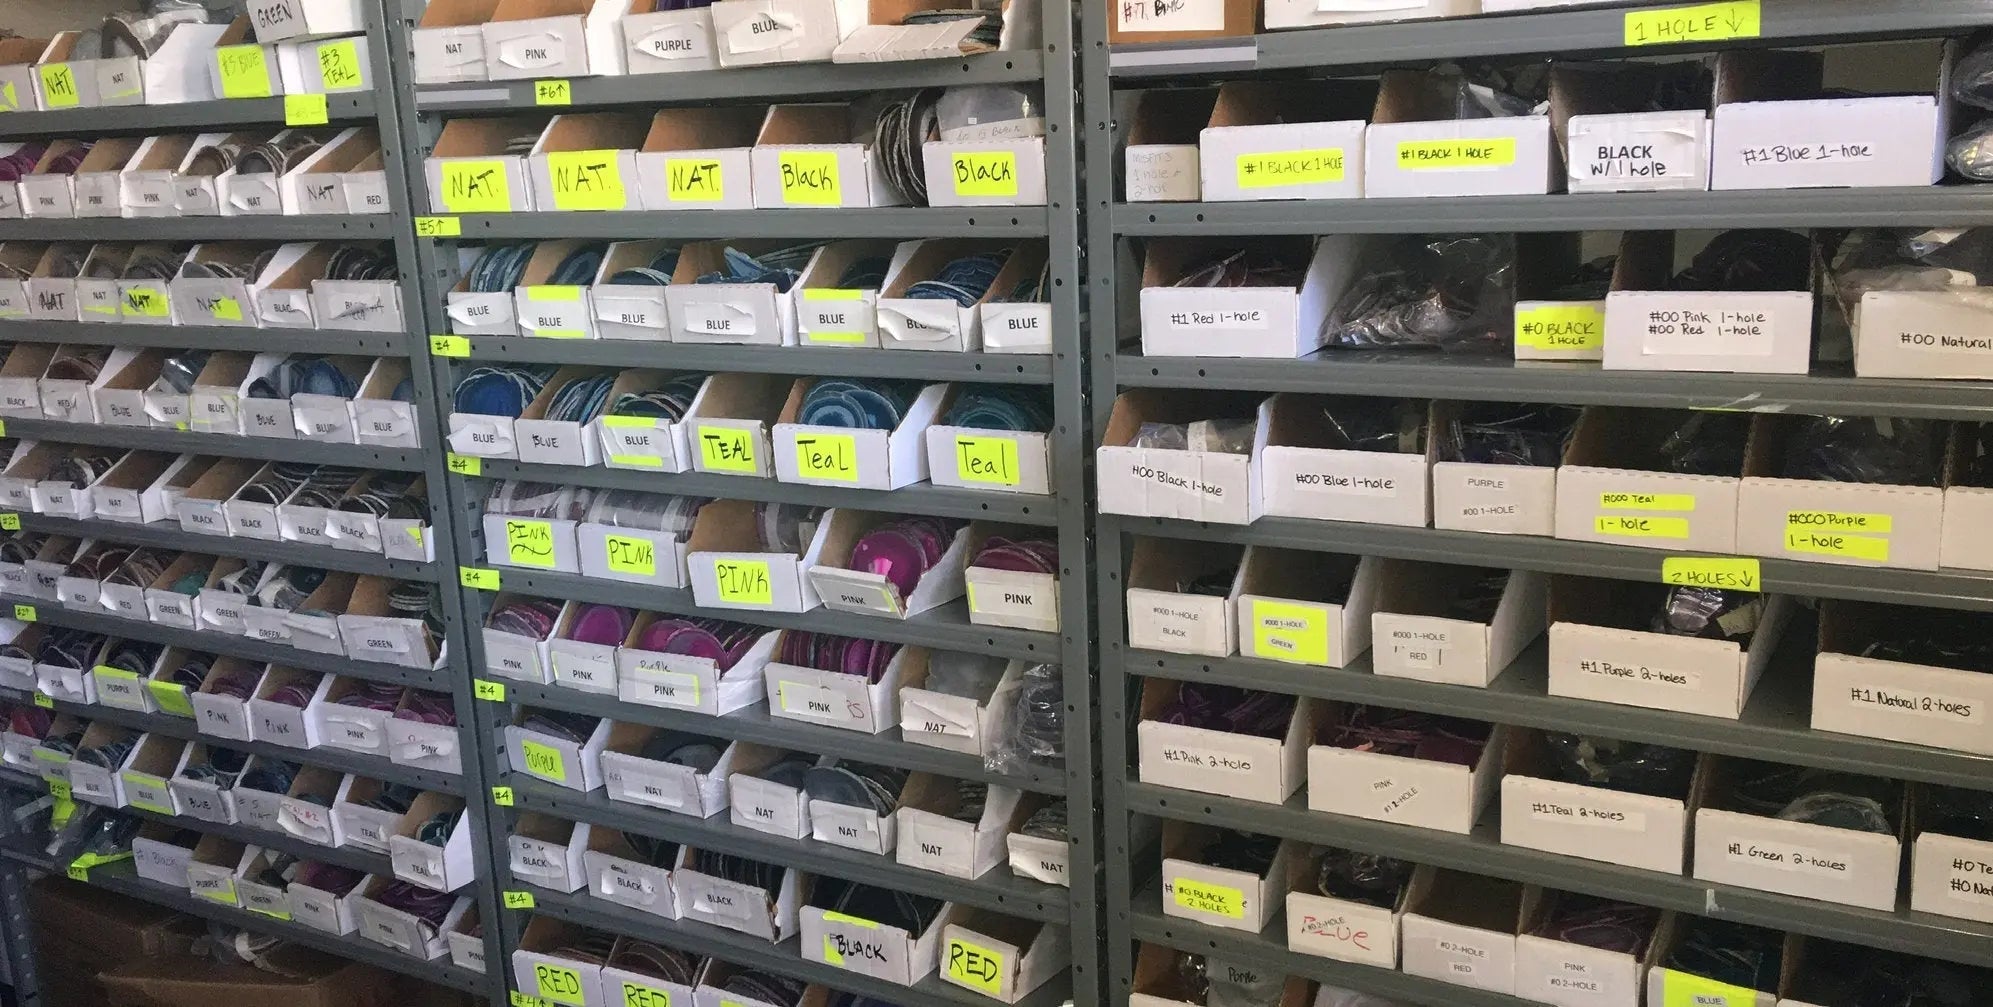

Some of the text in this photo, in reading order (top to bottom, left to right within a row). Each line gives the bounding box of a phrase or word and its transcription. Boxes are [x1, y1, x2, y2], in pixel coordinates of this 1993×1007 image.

[258, 2, 292, 27] GREEN
[752, 21, 779, 34] BLUE
[1658, 15, 1717, 35] HOLE
[445, 44, 462, 54] NAT
[655, 40, 692, 51] PURPLE
[525, 48, 547, 59] PINK
[45, 68, 73, 95] NAT
[1419, 148, 1451, 160] BLACK
[1466, 147, 1494, 159] HOLE
[1598, 145, 1653, 159] BLACK
[1775, 147, 1810, 163] Blue
[1267, 160, 1310, 174] BLACK
[1630, 162, 1666, 177] hole
[307, 185, 335, 201] NAT
[247, 197, 261, 207] NAT
[367, 196, 382, 205] RED
[467, 305, 489, 316] BLUE
[538, 317, 561, 327] BLUE
[621, 314, 645, 324] BLUE
[819, 313, 845, 324] BLUE
[1193, 312, 1214, 324] Red
[1682, 311, 1711, 324] Pink
[706, 320, 731, 330] BLUE
[1008, 318, 1038, 330] BLUE
[1547, 323, 1594, 335] BLACK
[1682, 324, 1705, 335] Red
[1558, 336, 1585, 345] HOLE
[1941, 336, 1992, 349] Natural
[207, 404, 225, 413] BLUE
[374, 422, 393, 432] BLUE
[473, 433, 495, 444] BLUE
[532, 434, 559, 448] BLUE
[626, 436, 649, 446] BLUE
[704, 435, 752, 462] TEAL
[1157, 470, 1188, 489] Black
[1323, 475, 1349, 487] Blue
[1468, 478, 1504, 489] PURPLE
[1633, 494, 1655, 503] Teal
[240, 518, 262, 528] BLACK
[1829, 514, 1866, 527] Purple
[298, 525, 320, 537] BLACK
[340, 525, 364, 539] BLACK
[508, 522, 550, 542] PINK
[608, 540, 653, 566] PINK
[718, 564, 768, 596] PINK
[1671, 571, 1737, 586] 2 HOLES
[841, 594, 865, 605] PINK
[1004, 593, 1032, 605] PINK
[216, 607, 238, 618] GREEN
[1162, 627, 1186, 637] BLACK
[367, 638, 392, 649] GREEN
[1409, 652, 1427, 661] RED
[503, 659, 522, 670] PINK
[573, 670, 593, 680] PINK
[654, 685, 675, 697] PINK
[808, 701, 830, 713] PINK
[924, 721, 946, 733] NAT
[346, 730, 366, 740] PINK
[1182, 750, 1204, 765] Pink
[755, 807, 774, 819] NAT
[1550, 804, 1573, 816] Teal
[839, 826, 857, 837] NAT
[922, 843, 942, 856] NAT
[1748, 845, 1783, 862] Green
[523, 856, 547, 867] BLACK
[1041, 861, 1063, 872] NAT
[617, 877, 641, 890] BLACK
[707, 894, 732, 906] BLACK
[1193, 891, 1225, 904] BLACK
[1198, 900, 1230, 914] HOLES
[836, 934, 887, 962] BLACK
[950, 943, 998, 982] RED
[1453, 964, 1472, 973] RED
[1564, 962, 1585, 972] PINK
[539, 966, 580, 995] RED
